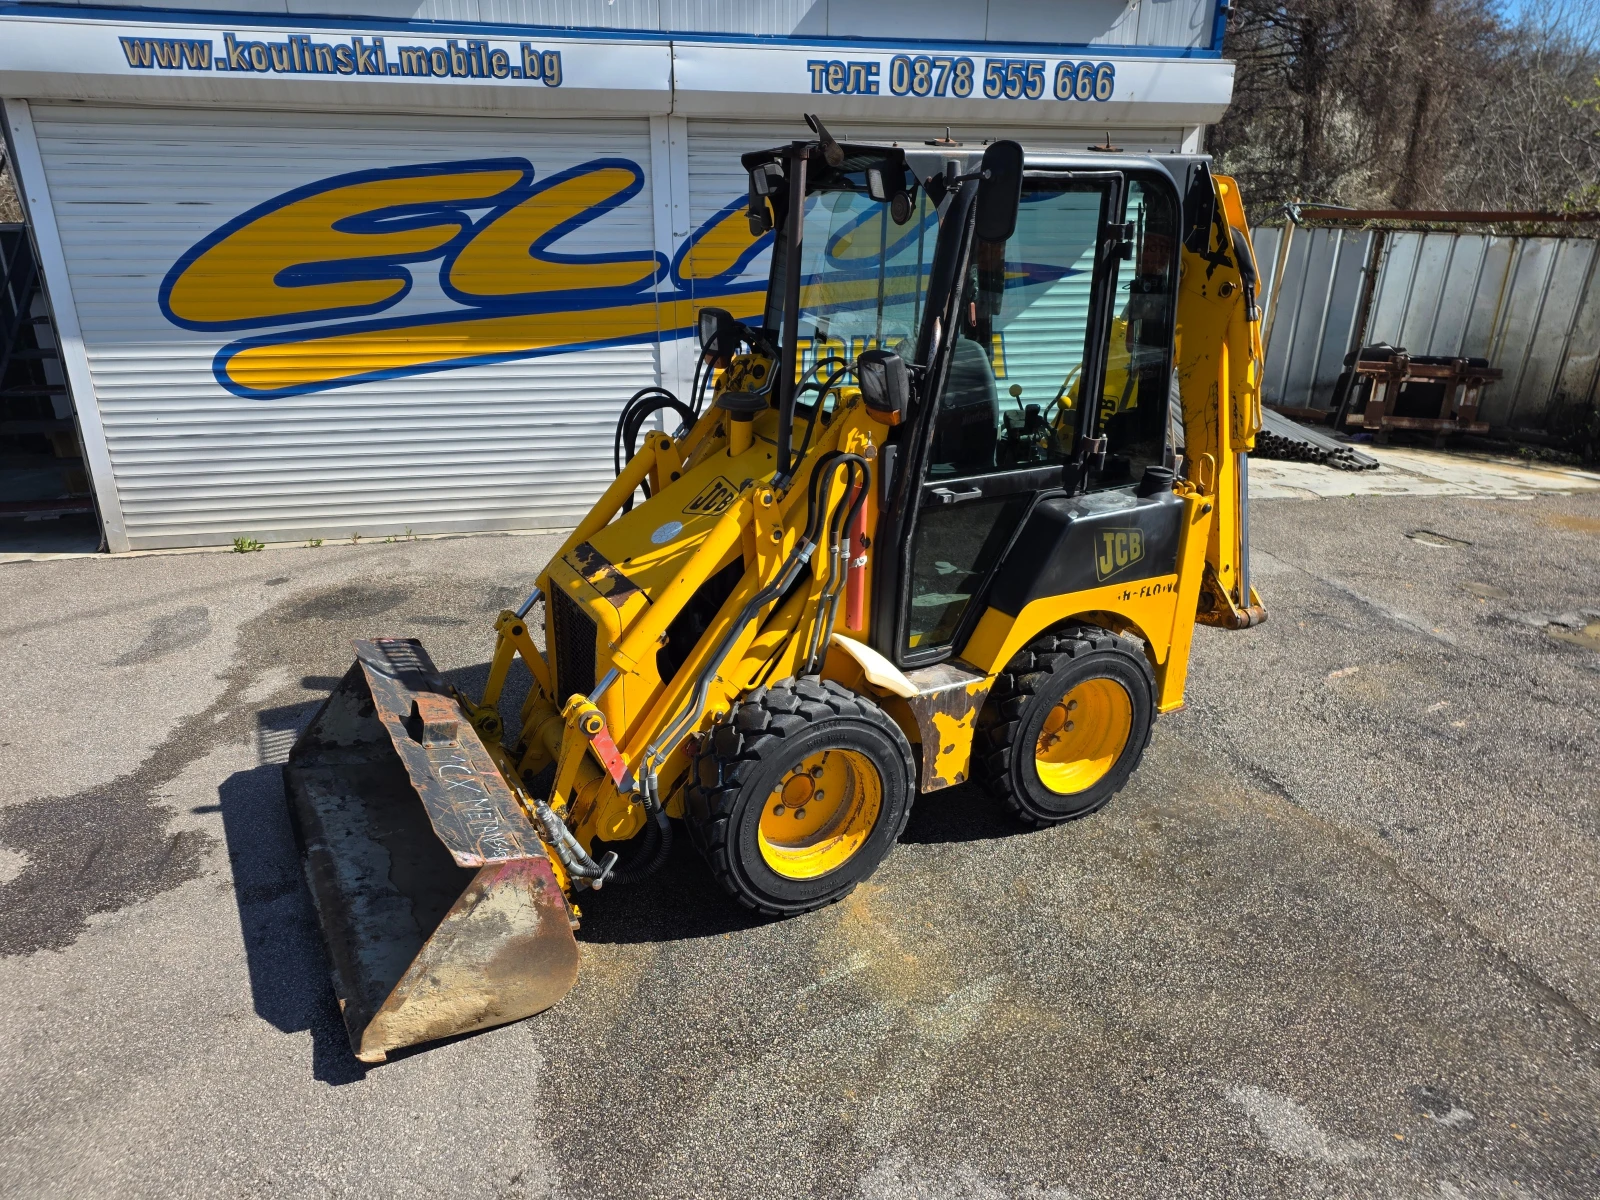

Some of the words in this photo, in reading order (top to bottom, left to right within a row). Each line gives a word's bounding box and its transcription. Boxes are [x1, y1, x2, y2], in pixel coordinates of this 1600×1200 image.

[120, 34, 561, 87] www.koulinski.mobile.bg
[808, 60, 880, 95] тел:
[890, 55, 973, 97] 0878
[983, 58, 1045, 99] 555
[1053, 61, 1115, 101] 666
[689, 481, 735, 512] JCB
[1099, 532, 1141, 575] JCB
